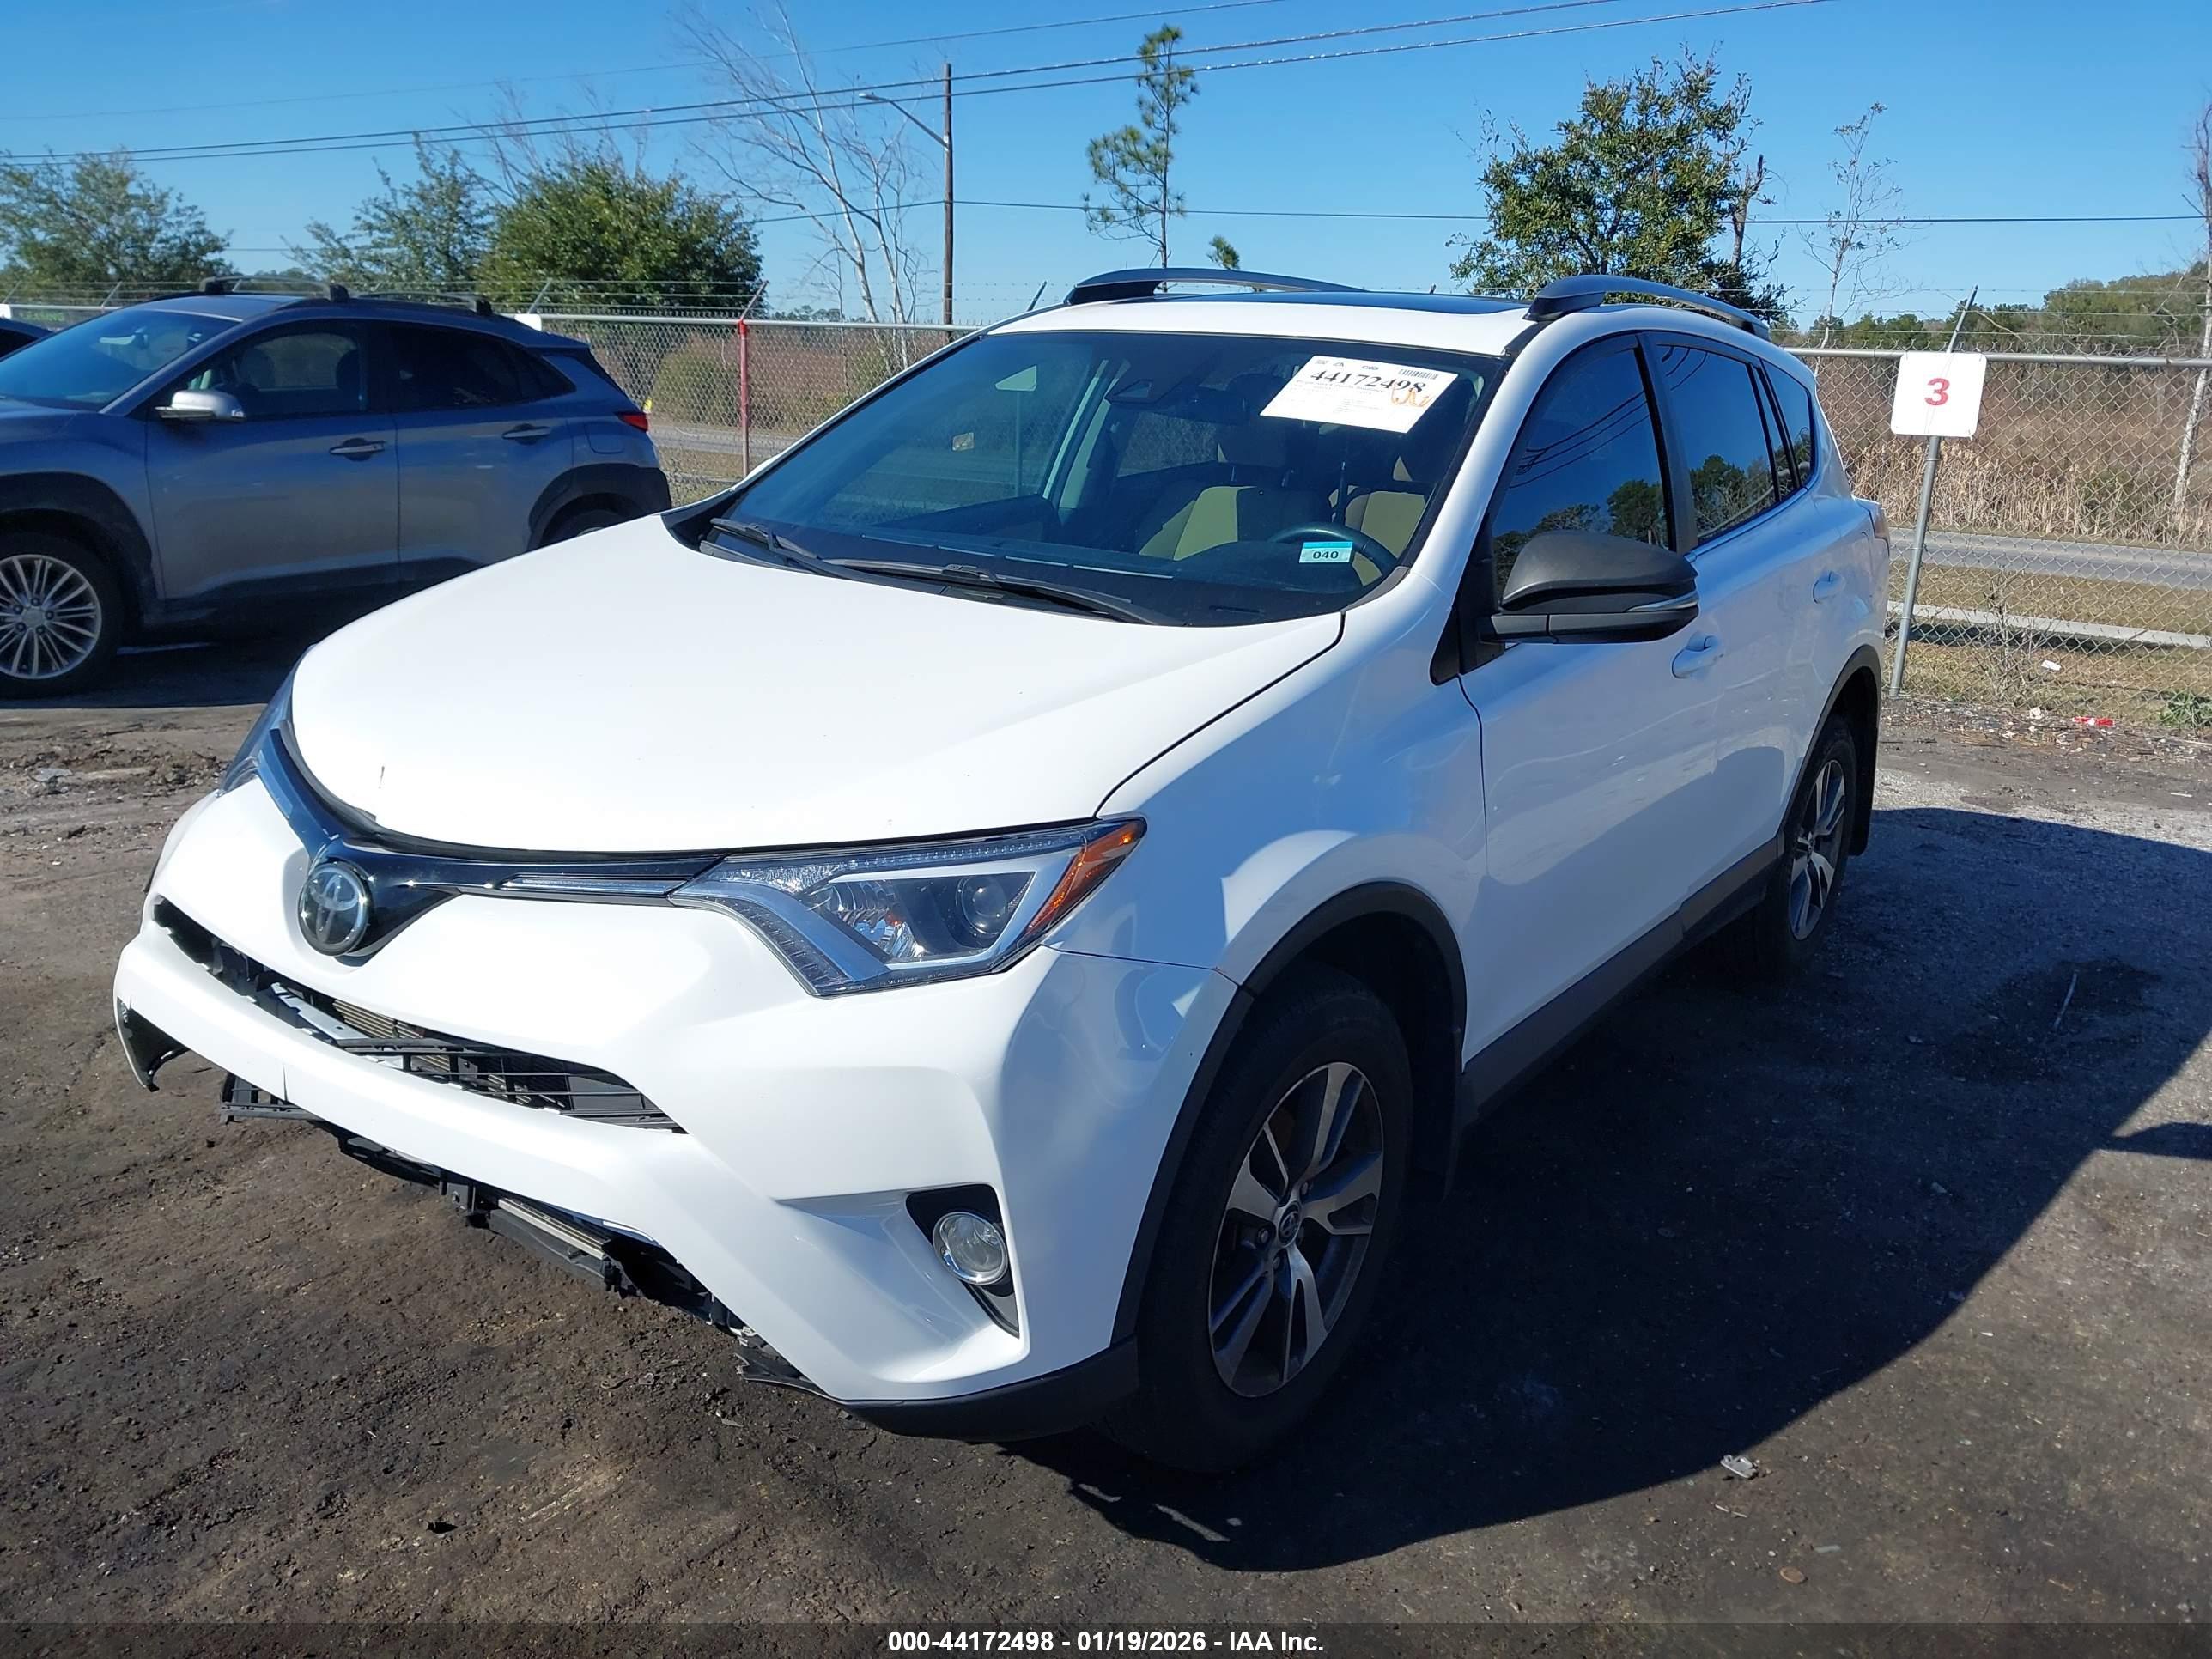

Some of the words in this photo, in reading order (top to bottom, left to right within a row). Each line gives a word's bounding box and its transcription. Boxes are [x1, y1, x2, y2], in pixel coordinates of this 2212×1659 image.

[1310, 370, 1426, 393] 44172498
[1924, 377, 1950, 406] 3
[1312, 550, 1339, 559] 040
